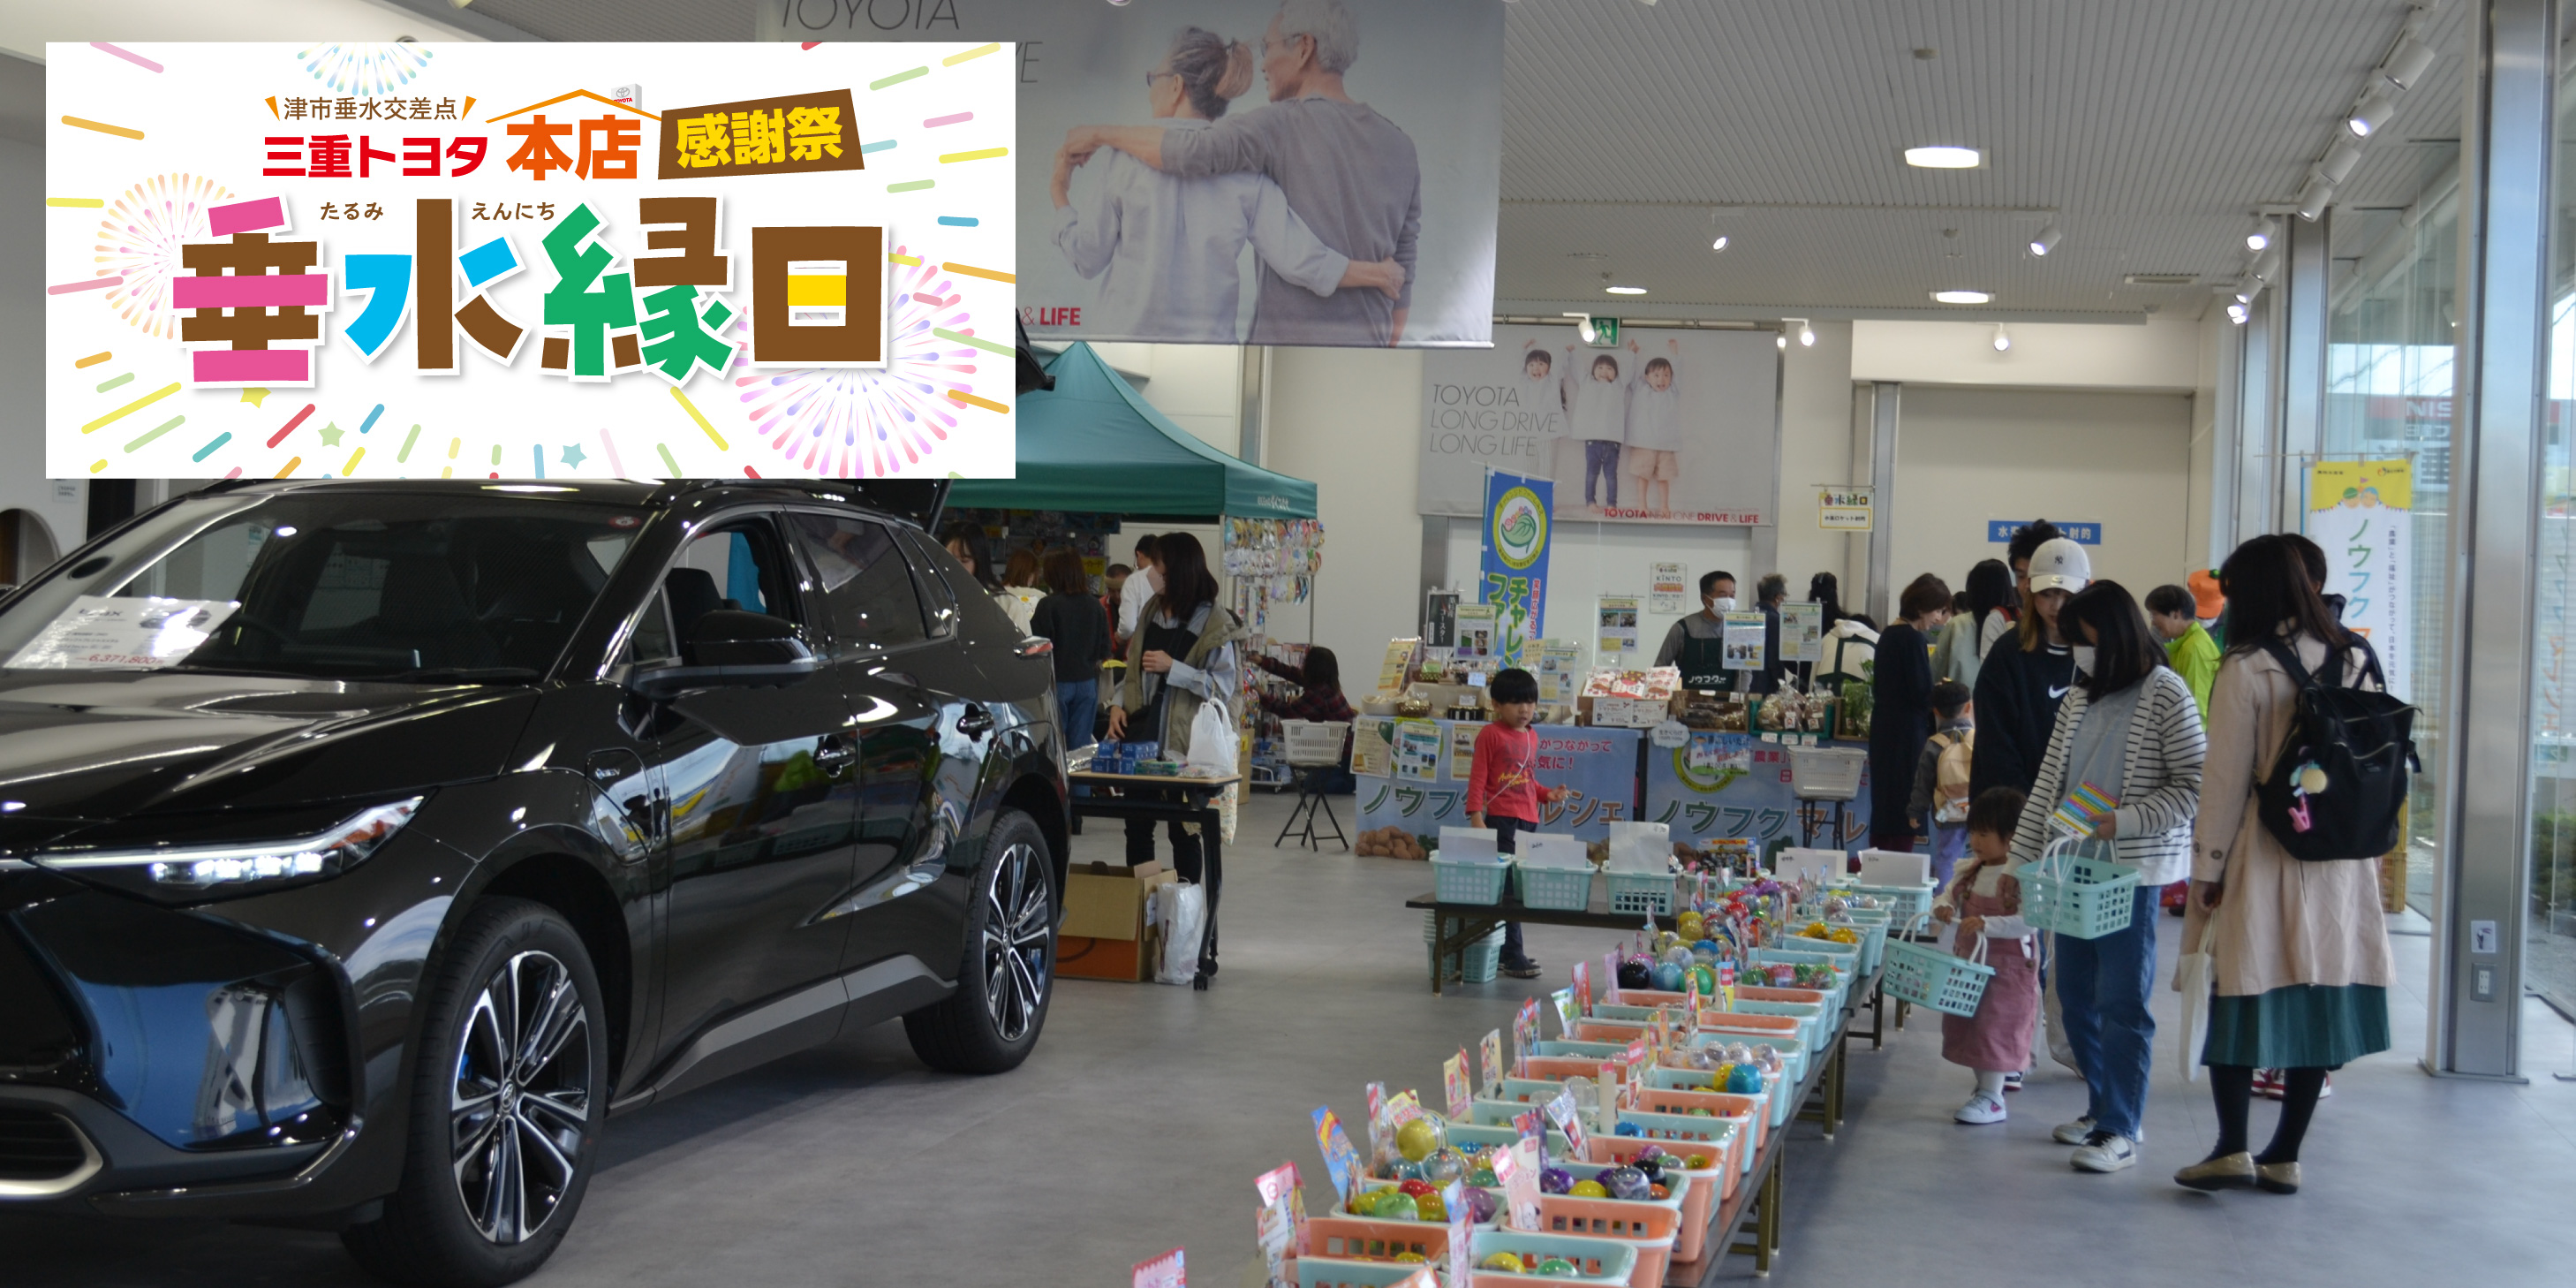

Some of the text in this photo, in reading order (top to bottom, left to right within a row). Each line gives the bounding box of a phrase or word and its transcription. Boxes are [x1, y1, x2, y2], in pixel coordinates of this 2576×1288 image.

[1039, 307, 1082, 326] LIFE
[1433, 383, 1520, 407] TOYOTA
[2406, 400, 2451, 418] NIS
[1431, 409, 1560, 433] LONG DRIVE
[1430, 433, 1537, 456] LONG LIFE
[1604, 508, 1648, 519] TOYOTA
[1697, 512, 1729, 523] DRIVE
[1739, 514, 1759, 524] LIFE
[1539, 739, 1613, 753] がつながって
[1530, 756, 1575, 770] 気に!
[1364, 784, 1626, 827] ノウフルシェ
